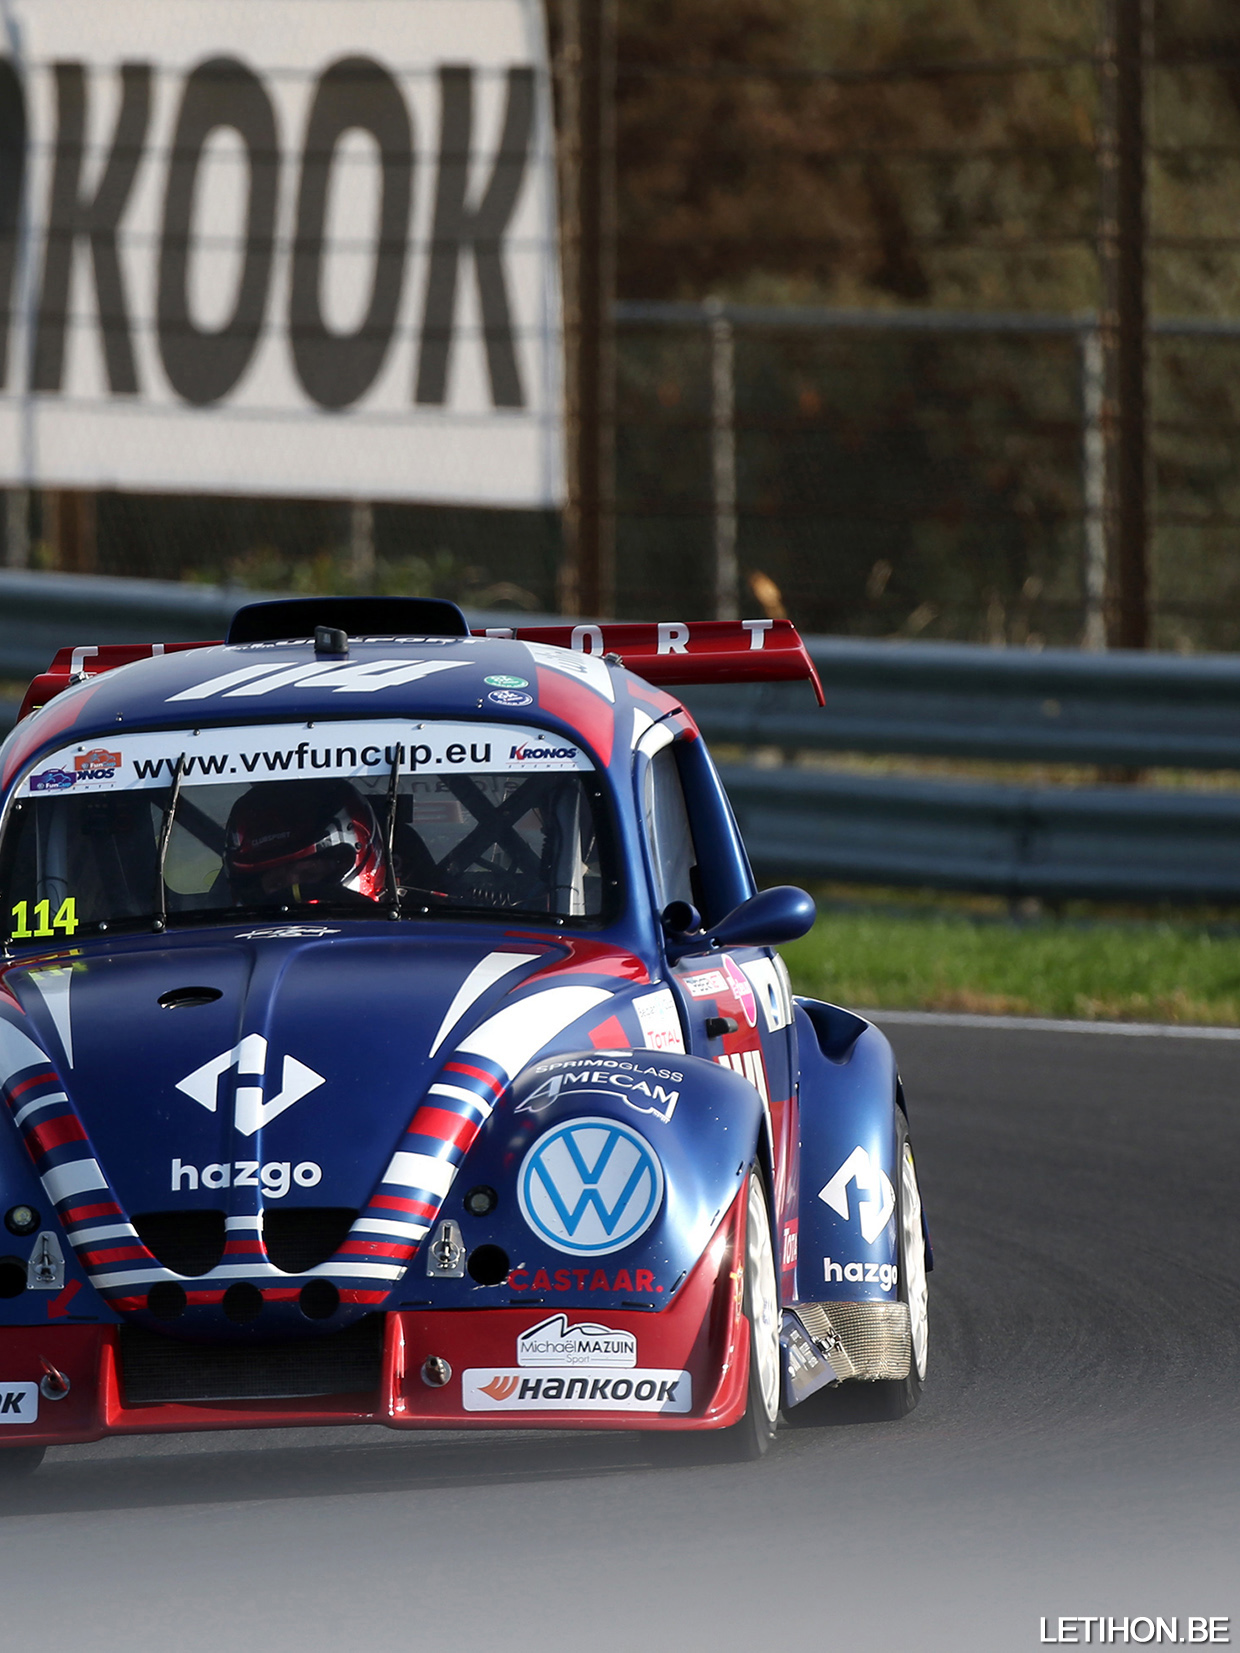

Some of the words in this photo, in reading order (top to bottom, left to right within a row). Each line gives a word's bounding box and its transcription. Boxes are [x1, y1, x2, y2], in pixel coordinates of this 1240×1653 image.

[164, 659, 476, 702] 114
[133, 741, 491, 780] www.vwfuncup.eu
[509, 742, 578, 760] KRONOS
[11, 897, 79, 938] 114
[535, 1059, 684, 1083] SPRIMOGLASS
[171, 1158, 323, 1199] hazgo
[566, 1355, 591, 1365] Sport
